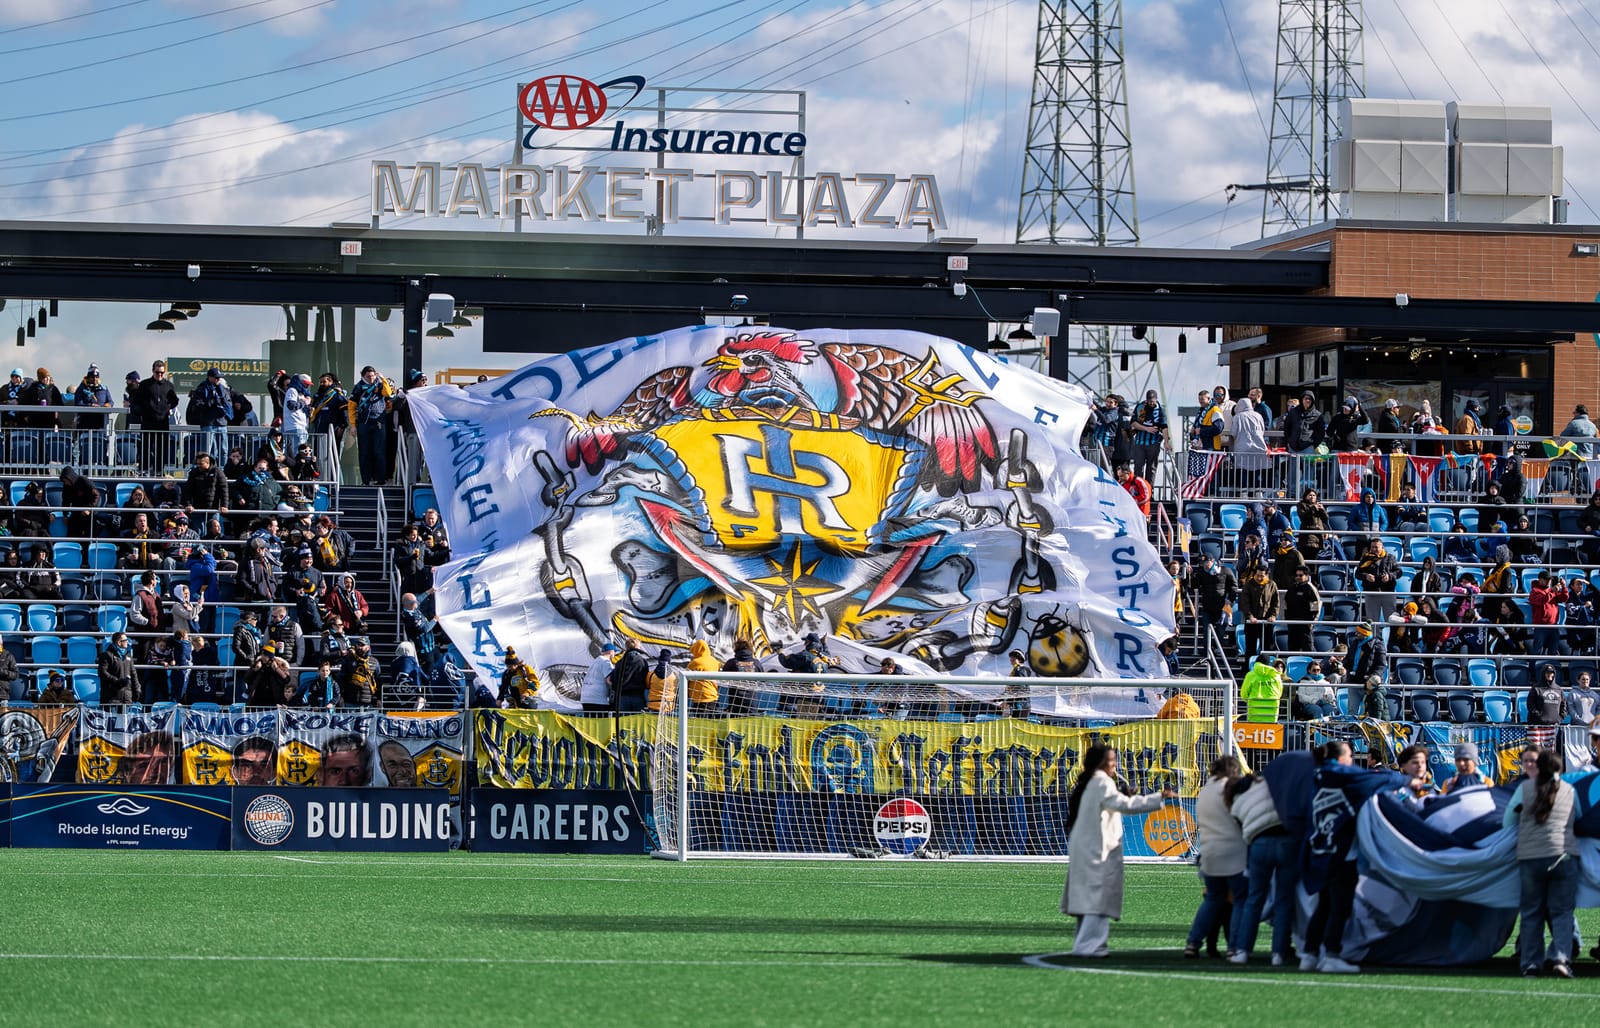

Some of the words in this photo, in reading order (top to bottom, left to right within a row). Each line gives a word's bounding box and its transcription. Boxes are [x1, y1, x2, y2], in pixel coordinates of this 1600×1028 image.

[526, 76, 600, 127] AAA
[611, 121, 807, 156] Insurance
[371, 160, 694, 224] MARKET
[714, 169, 948, 229] PLAZA
[207, 361, 250, 372] FROZEN
[185, 714, 275, 735] AMOS
[1233, 727, 1276, 744] 6-115
[58, 823, 99, 835] Rhode
[102, 823, 140, 835] Island
[307, 802, 450, 840] BUILDING
[490, 803, 631, 842] CAREERS
[877, 820, 928, 833] PEPSI
